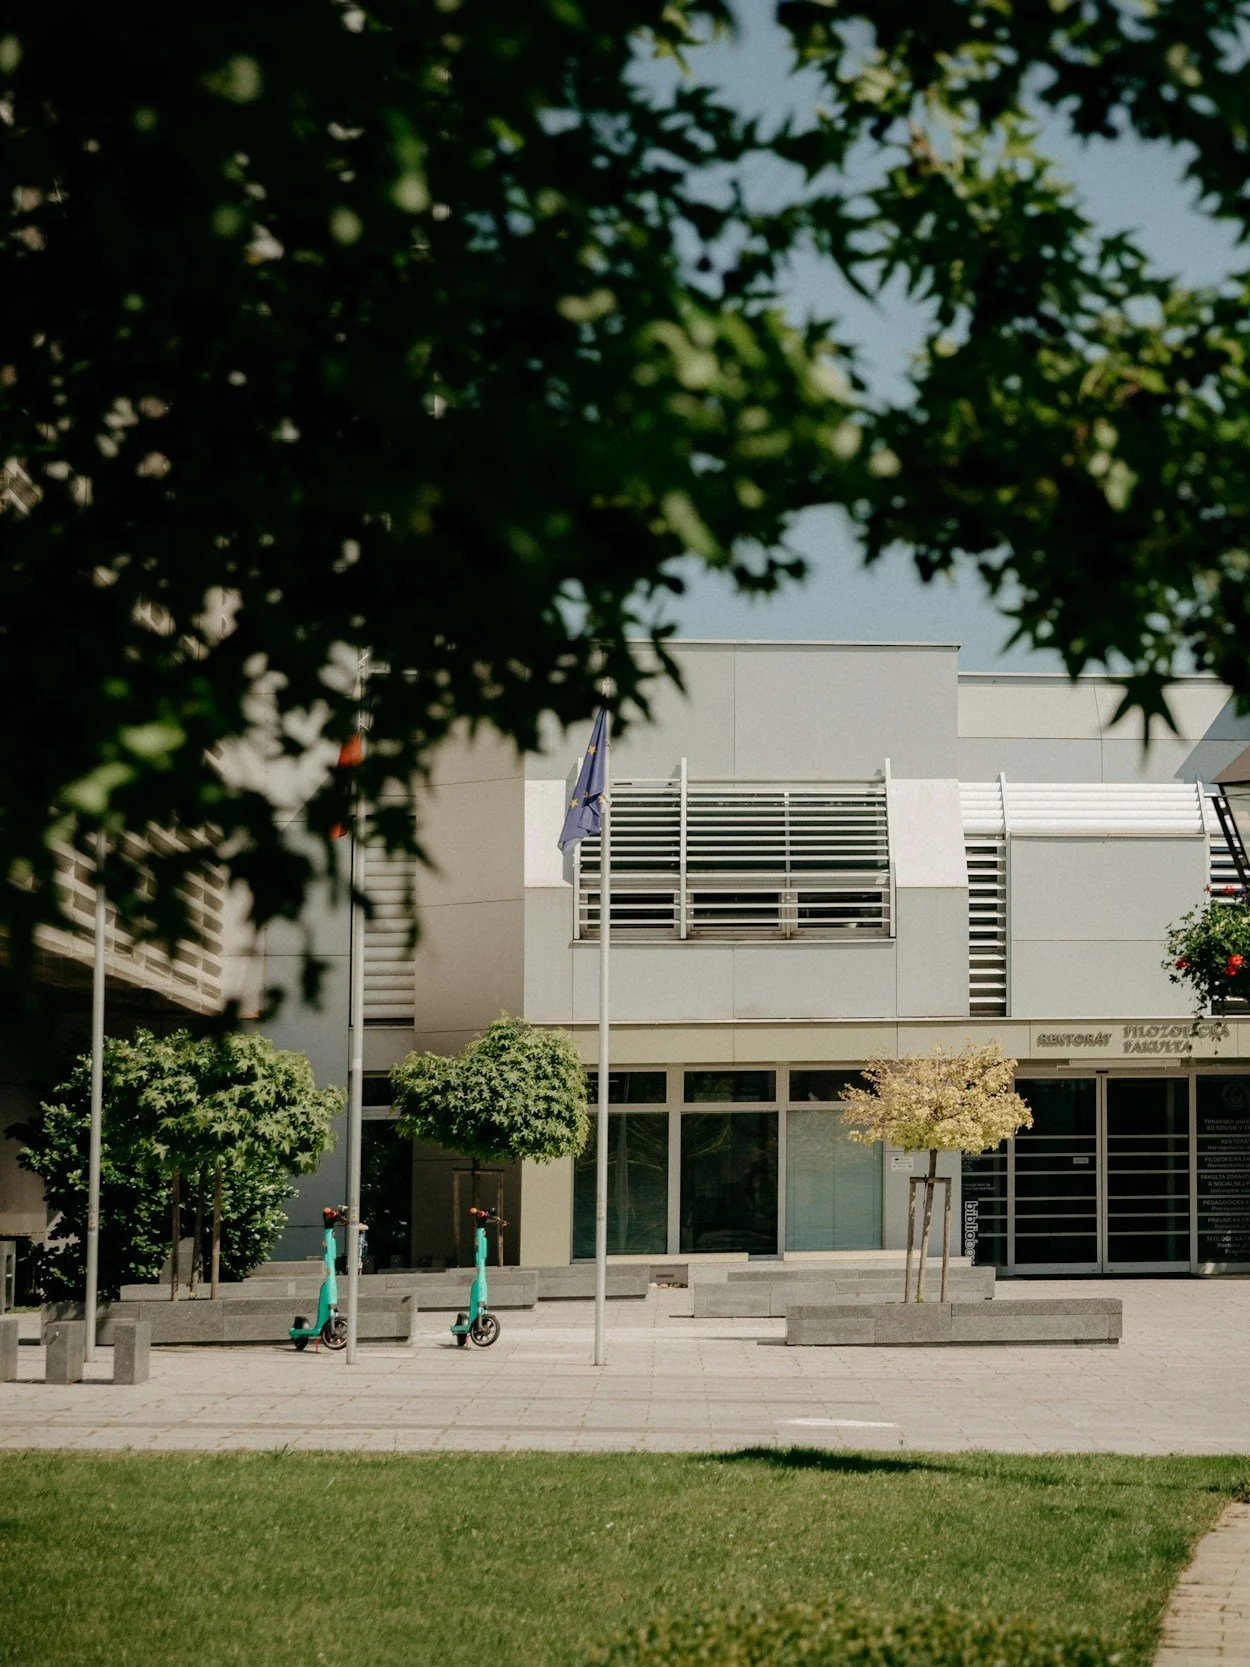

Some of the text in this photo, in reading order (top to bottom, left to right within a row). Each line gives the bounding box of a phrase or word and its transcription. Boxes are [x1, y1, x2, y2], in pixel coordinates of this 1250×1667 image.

[1123, 1024, 1231, 1038] FILOZOFCKÁ
[1037, 1032, 1112, 1047] REKTORÁT
[1123, 1040, 1193, 1053] FAKULTA
